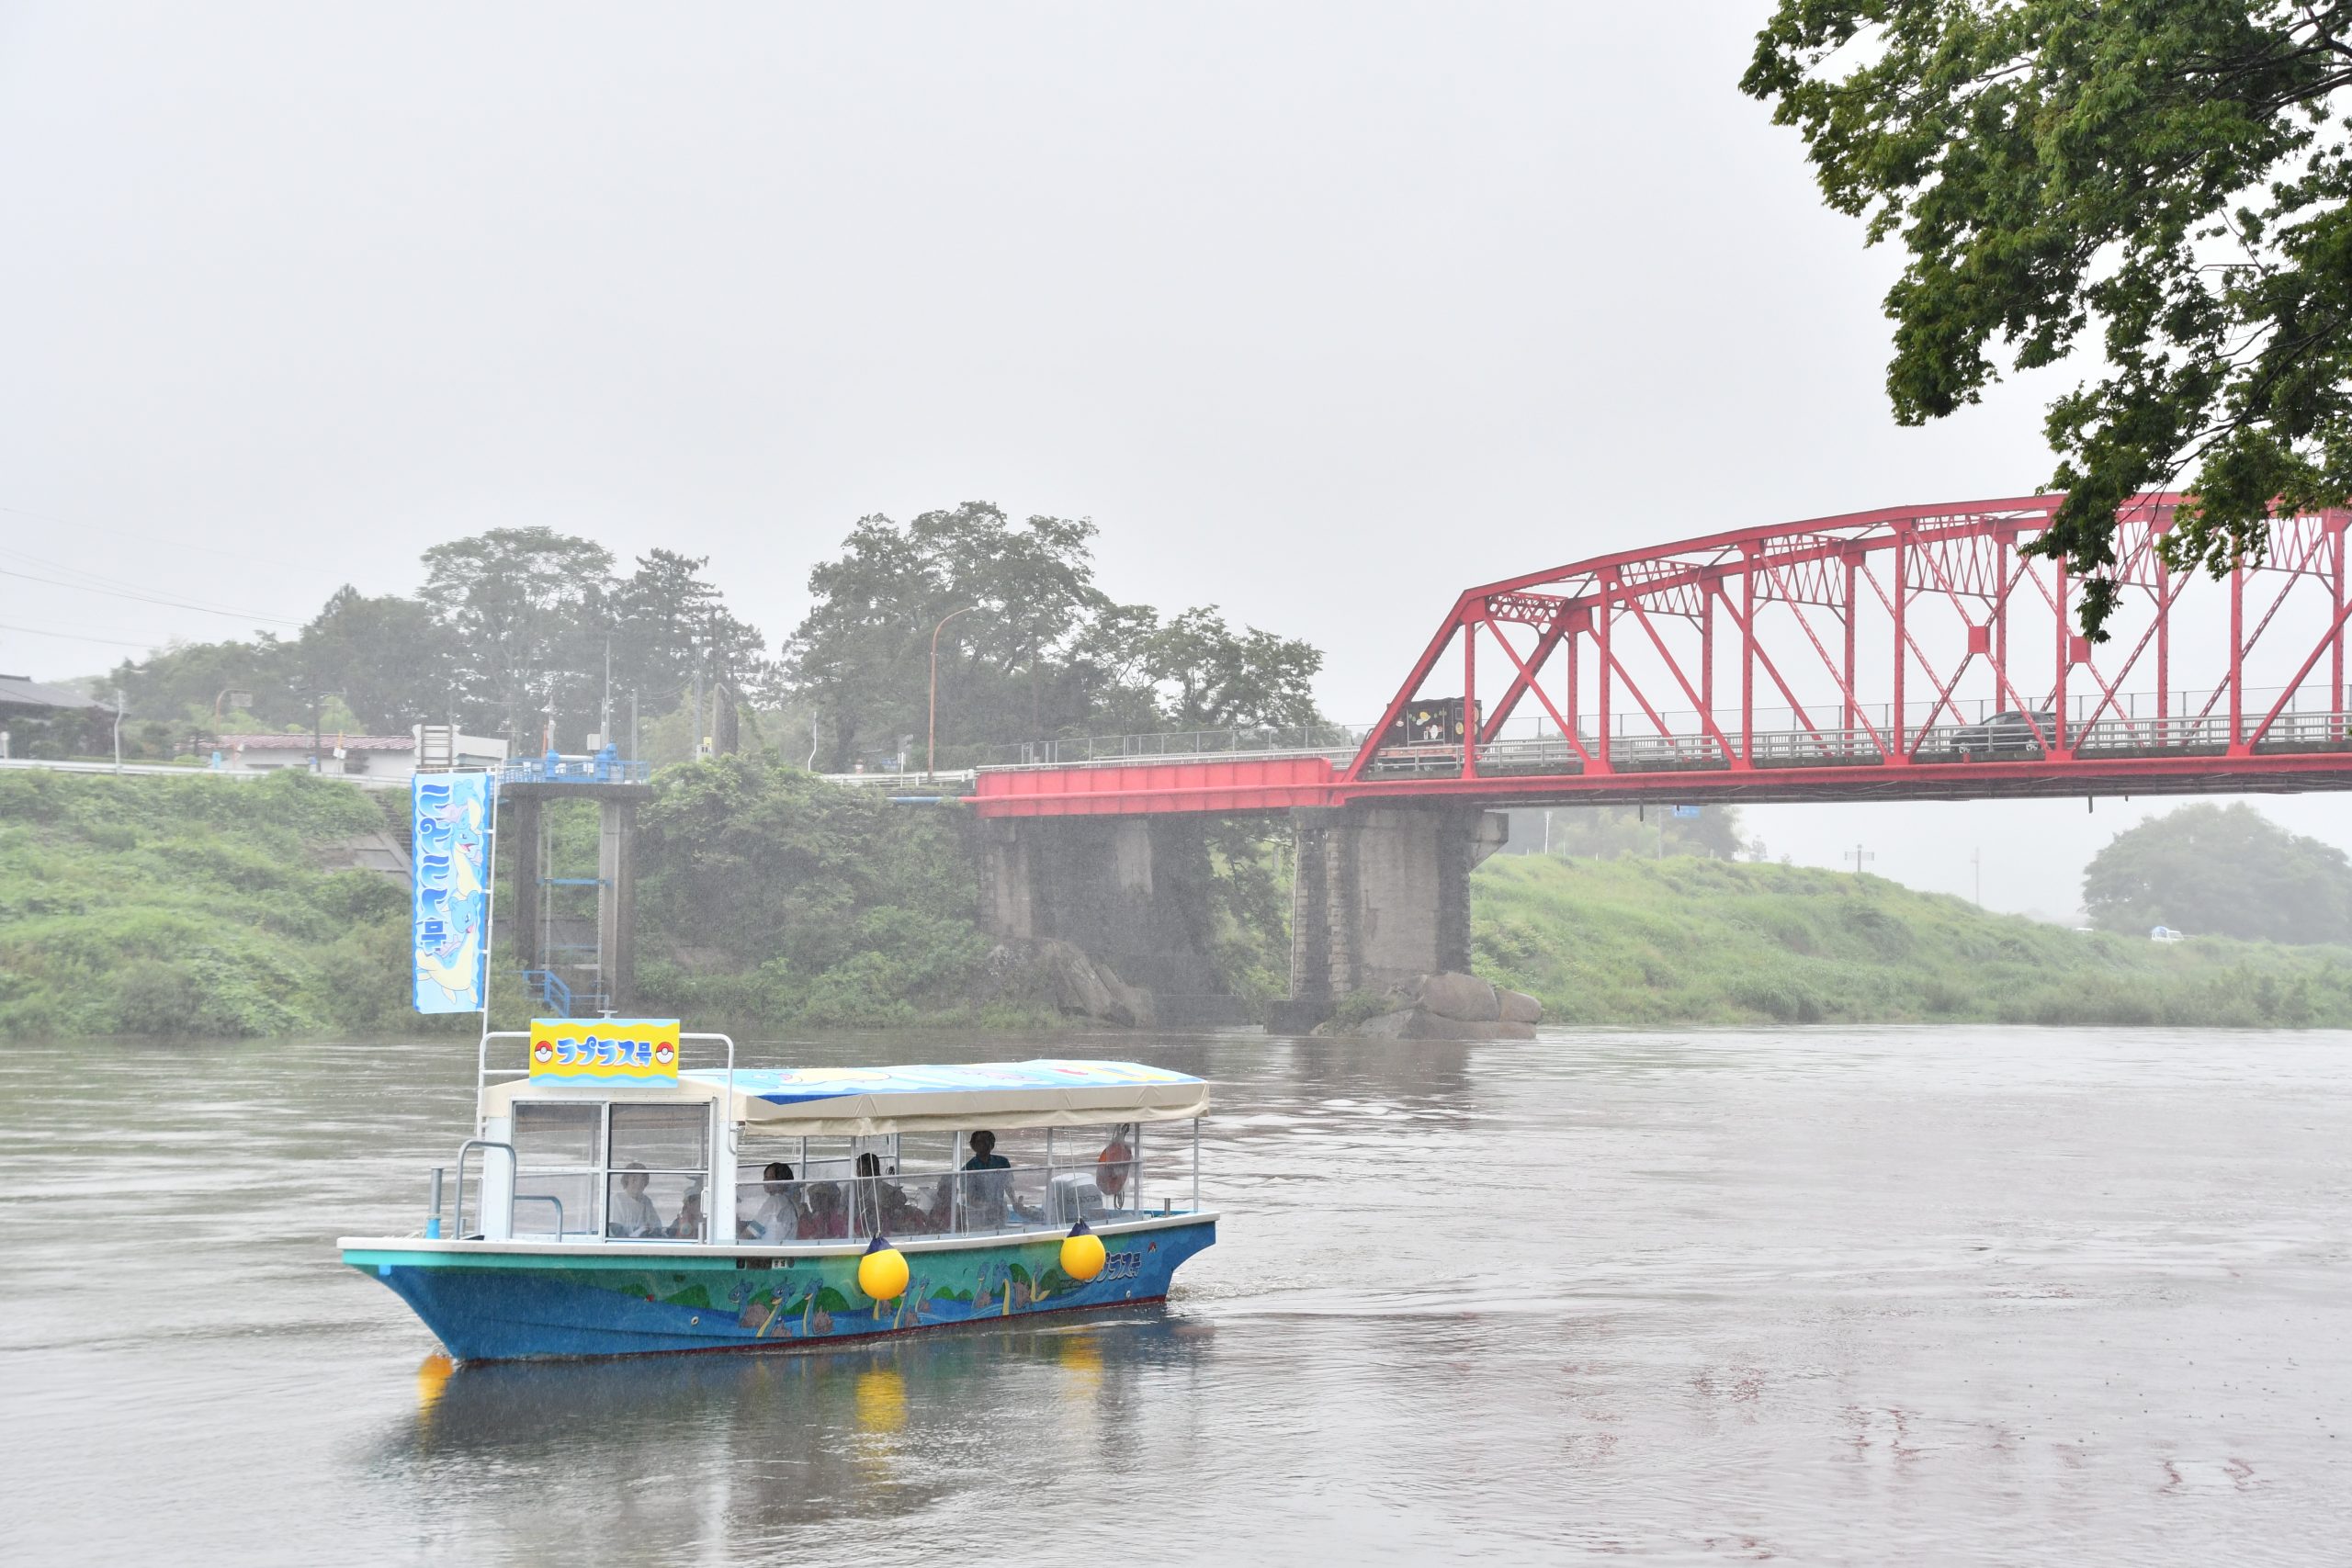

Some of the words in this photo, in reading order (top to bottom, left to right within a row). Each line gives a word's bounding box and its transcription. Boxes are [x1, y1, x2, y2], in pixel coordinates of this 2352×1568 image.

[556, 1035, 652, 1067] ラプラス号
